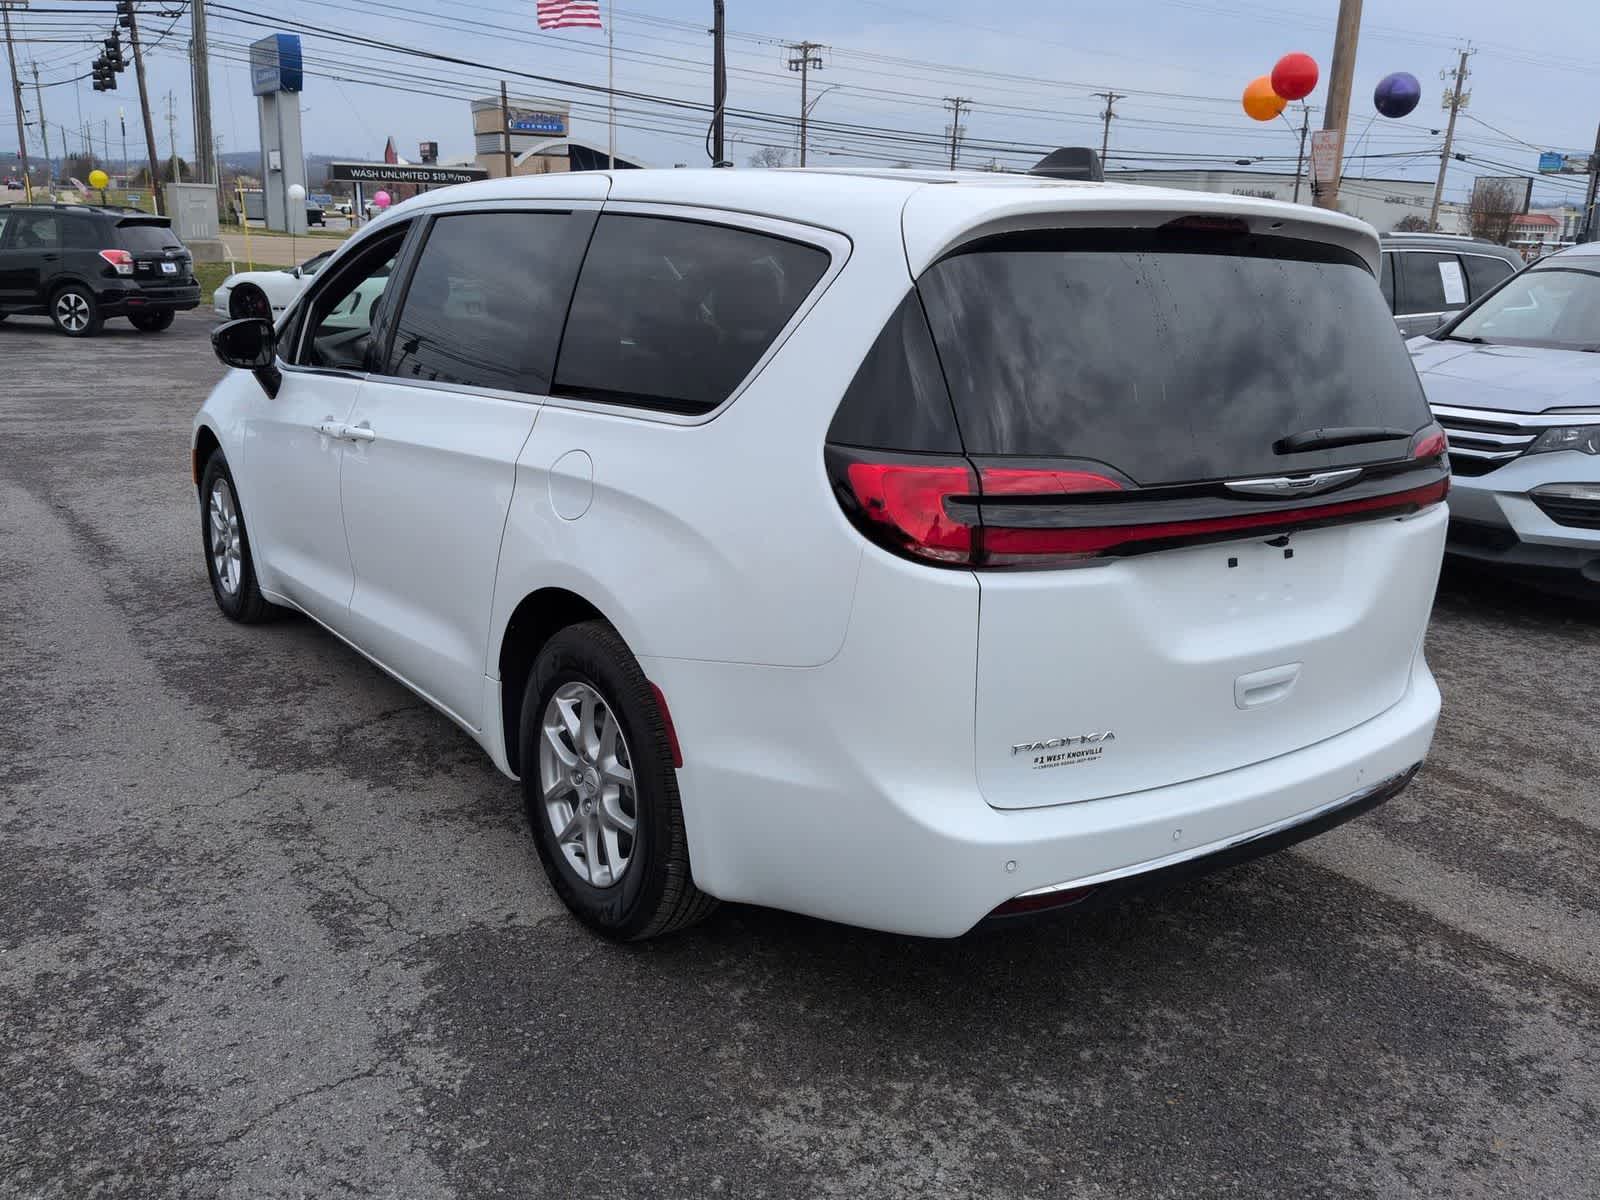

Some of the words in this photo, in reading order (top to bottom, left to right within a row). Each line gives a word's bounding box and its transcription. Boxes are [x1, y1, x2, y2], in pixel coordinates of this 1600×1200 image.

[350, 169, 379, 178] WASH
[381, 170, 430, 181] UNLIMITED
[1012, 730, 1115, 755] PACIFICA
[1046, 753, 1066, 763] WEST
[1066, 746, 1103, 760] KNOXVILLE
